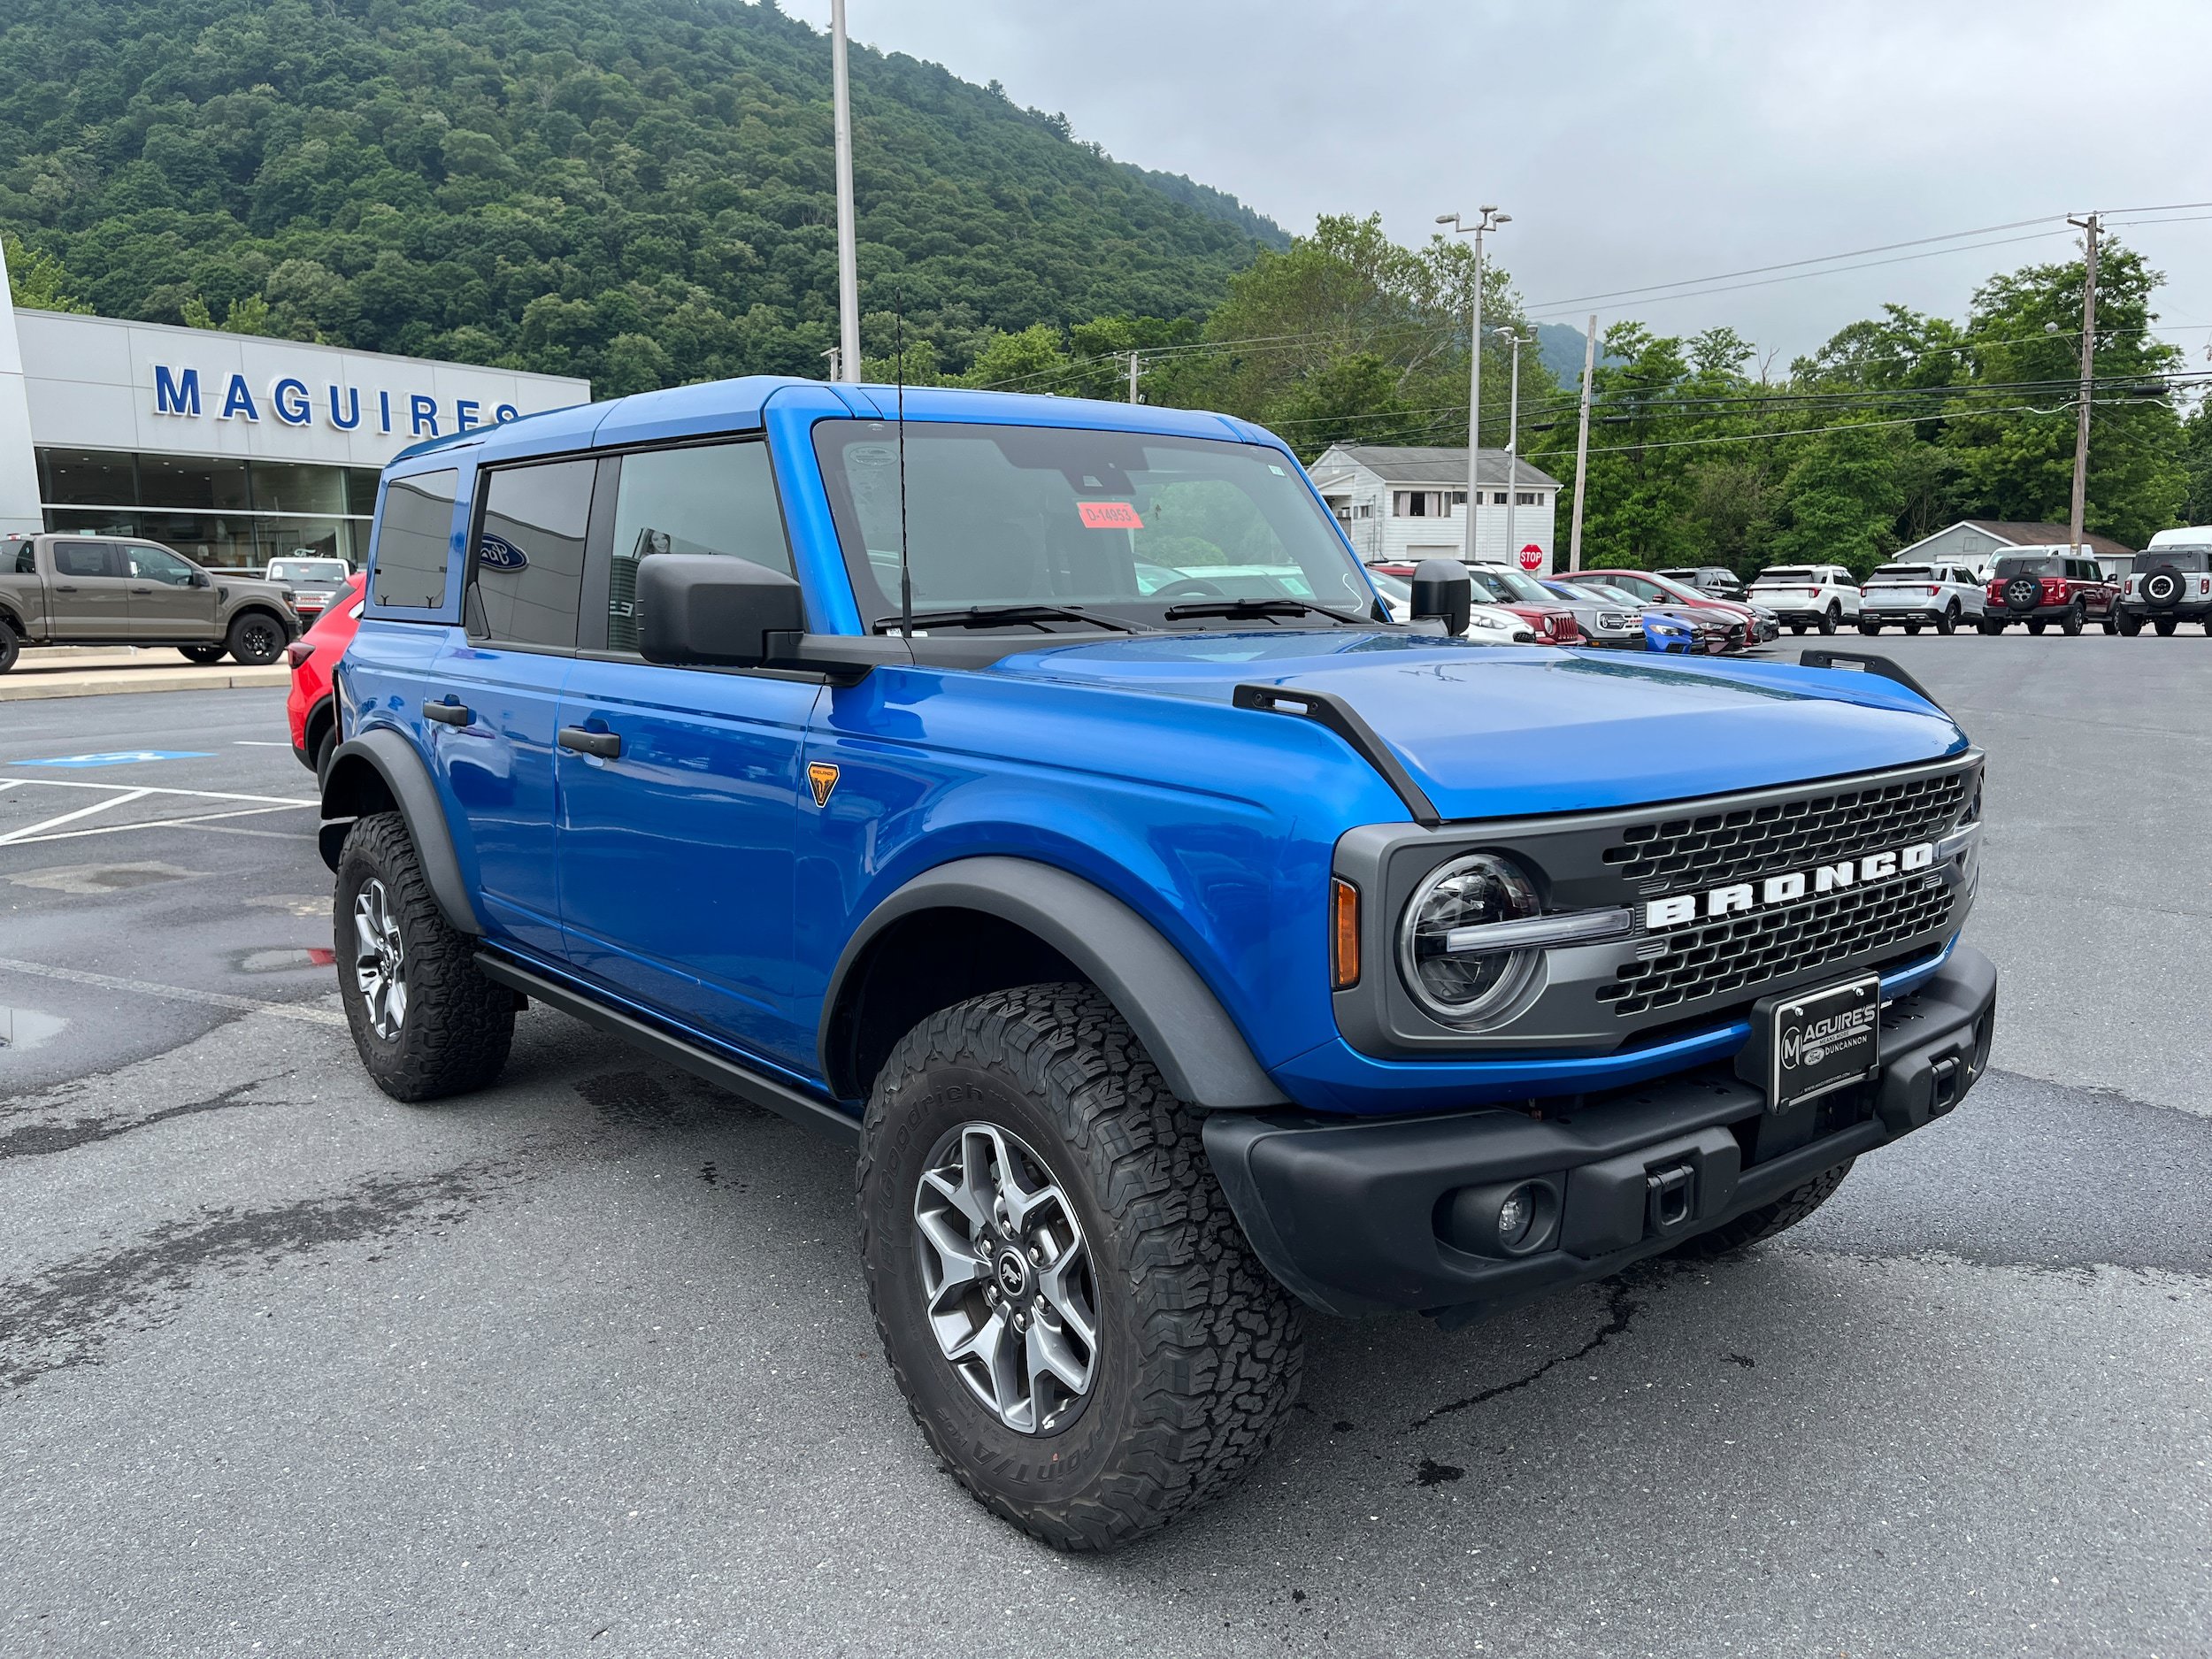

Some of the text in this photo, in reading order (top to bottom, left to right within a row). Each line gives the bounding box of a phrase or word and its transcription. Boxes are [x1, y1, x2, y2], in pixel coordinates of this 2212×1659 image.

[1086, 508, 1132, 521] D-14953
[1520, 551, 1541, 563] STOP
[1647, 842, 1933, 929] BRONCO
[1819, 1030, 1849, 1044] MEANS MORE
[1824, 1034, 1868, 1056] DUNCANNON
